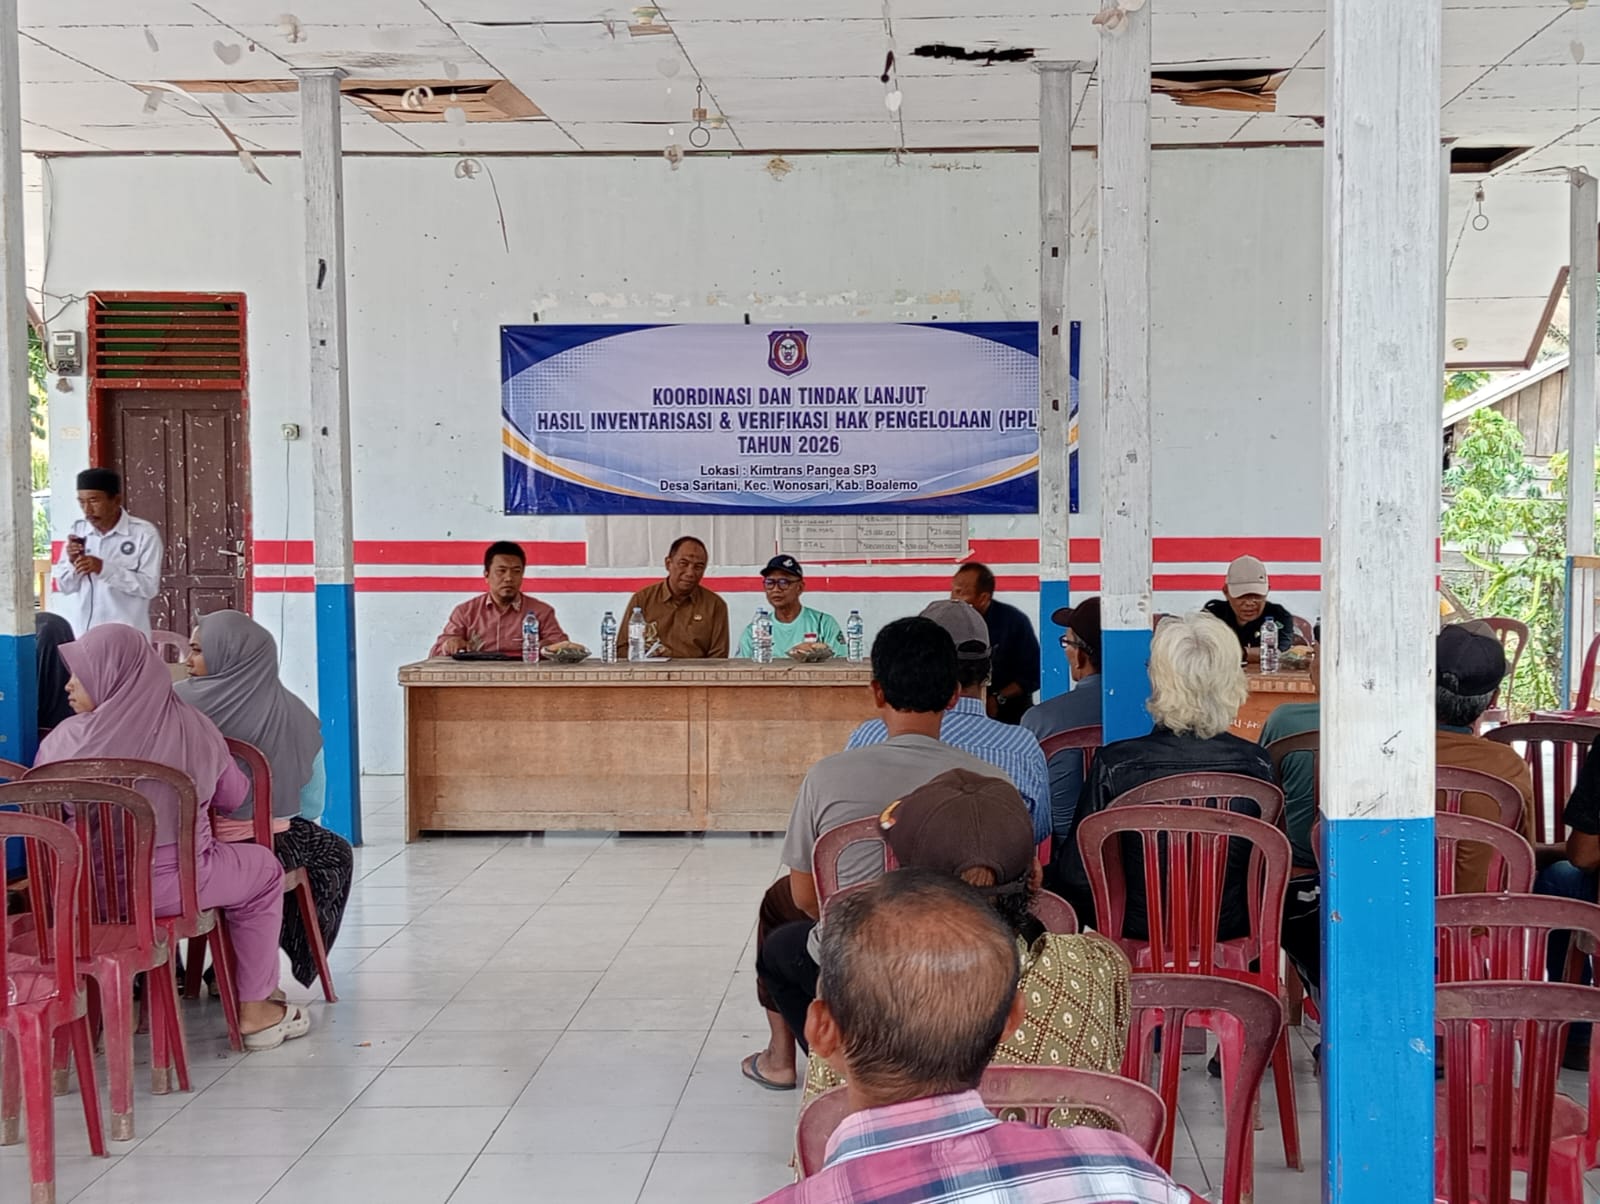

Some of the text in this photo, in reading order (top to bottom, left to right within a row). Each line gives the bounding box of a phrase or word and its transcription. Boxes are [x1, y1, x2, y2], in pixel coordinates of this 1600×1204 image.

[652, 386, 926, 406] KOORDINASI DAN TINDAK LANJUT
[536, 411, 585, 431] HASIL
[590, 411, 712, 430] INVENTARISASI
[719, 411, 732, 430] &
[737, 411, 829, 430] VERIFIKASI
[835, 411, 869, 429] HAK
[874, 410, 992, 429] PENGELOLAAN
[737, 435, 840, 454] TAHUN 2026
[700, 464, 740, 476] Lokasi
[749, 464, 803, 476] Kimtrans
[806, 464, 850, 479] Pangea
[853, 464, 877, 476] SP3
[660, 479, 919, 494] Desa Saritani, Kec. Wonosari, Kab. Boalemo
